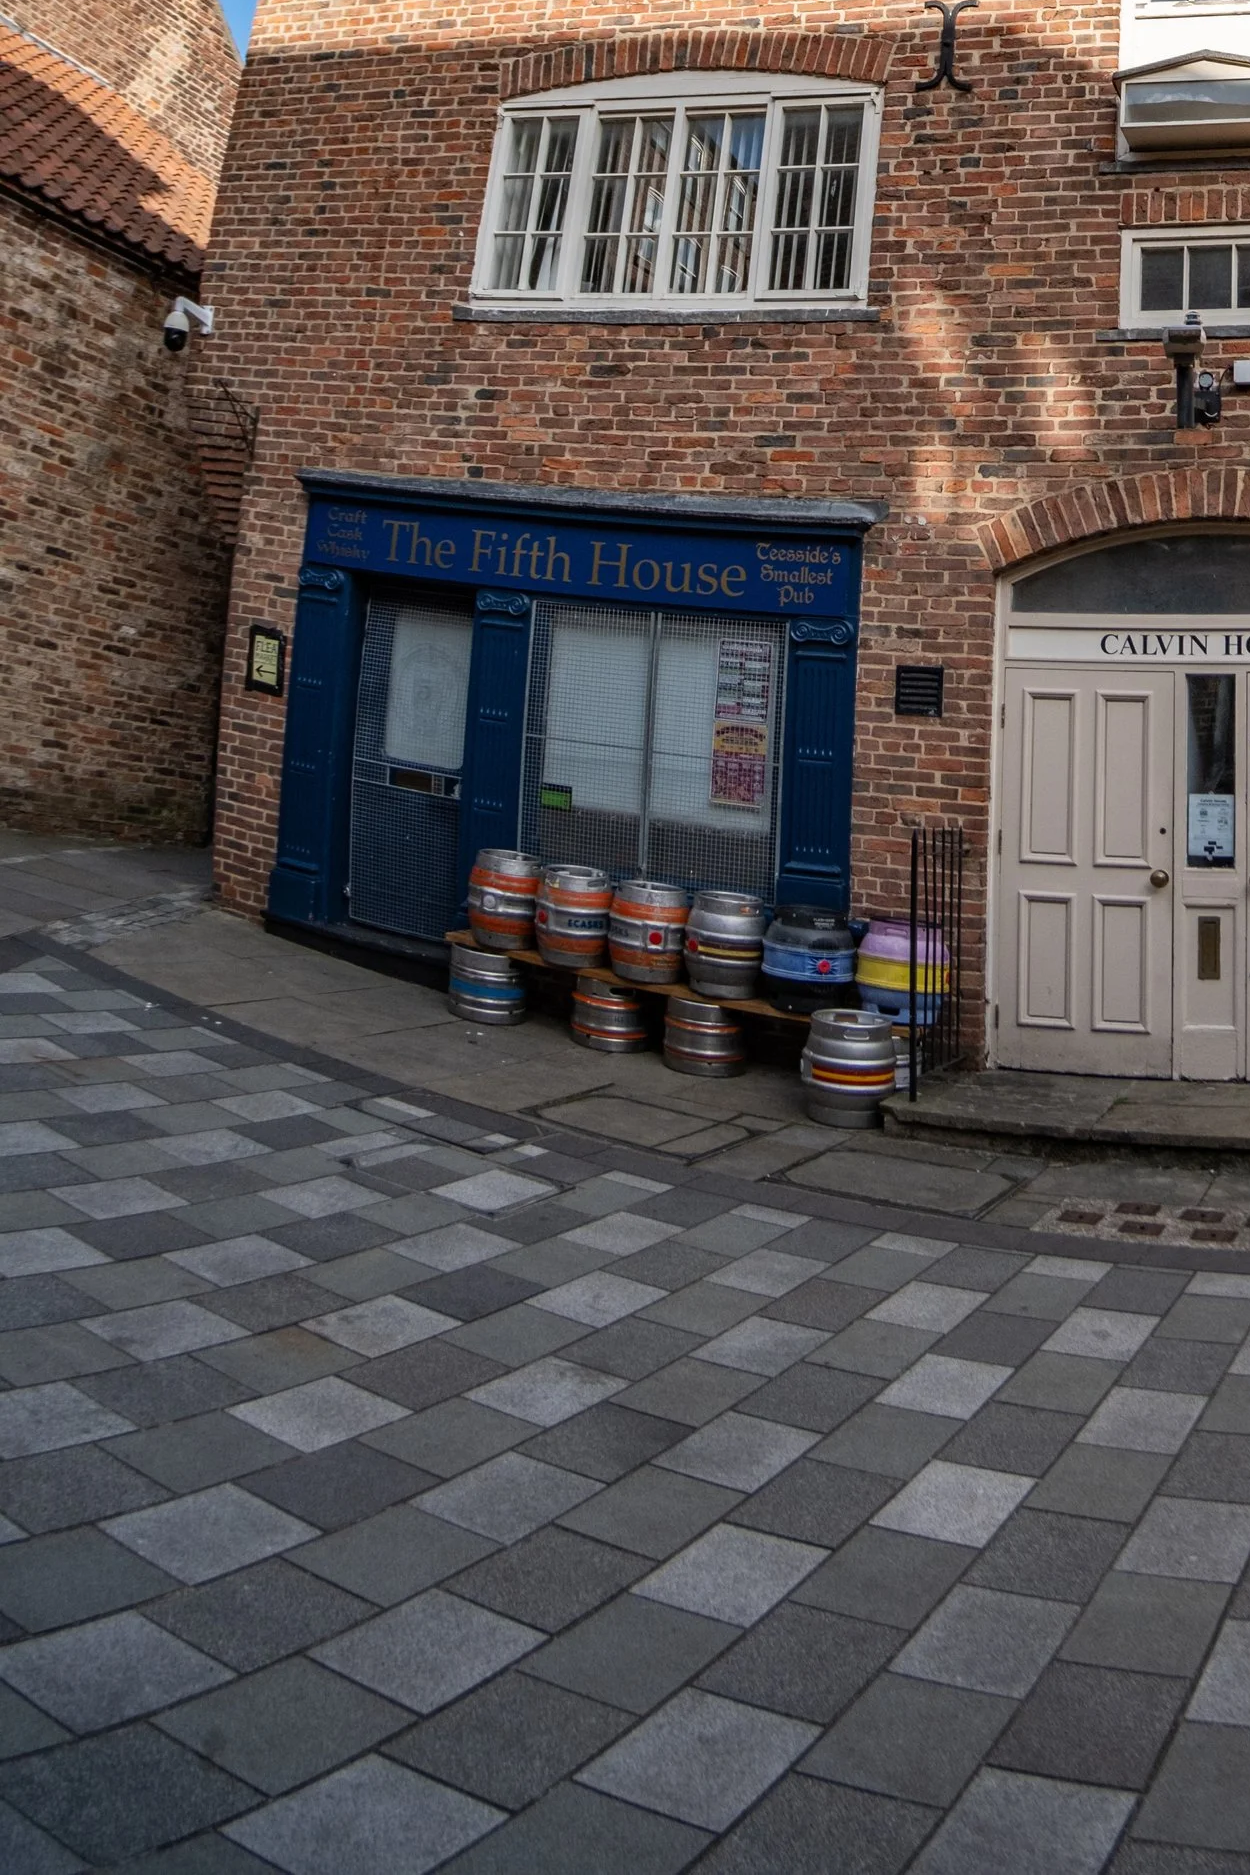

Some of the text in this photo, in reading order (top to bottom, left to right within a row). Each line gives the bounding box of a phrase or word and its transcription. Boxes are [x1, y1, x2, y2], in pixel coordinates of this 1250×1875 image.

[328, 506, 368, 524] Craft
[327, 523, 363, 540] Cask
[382, 519, 748, 598] The Fifth House
[755, 541, 841, 565] Teesside's
[760, 563, 834, 585] Smallest
[776, 584, 815, 607] Pub
[256, 640, 278, 654] FLEA
[1100, 633, 1208, 656] CALVIN
